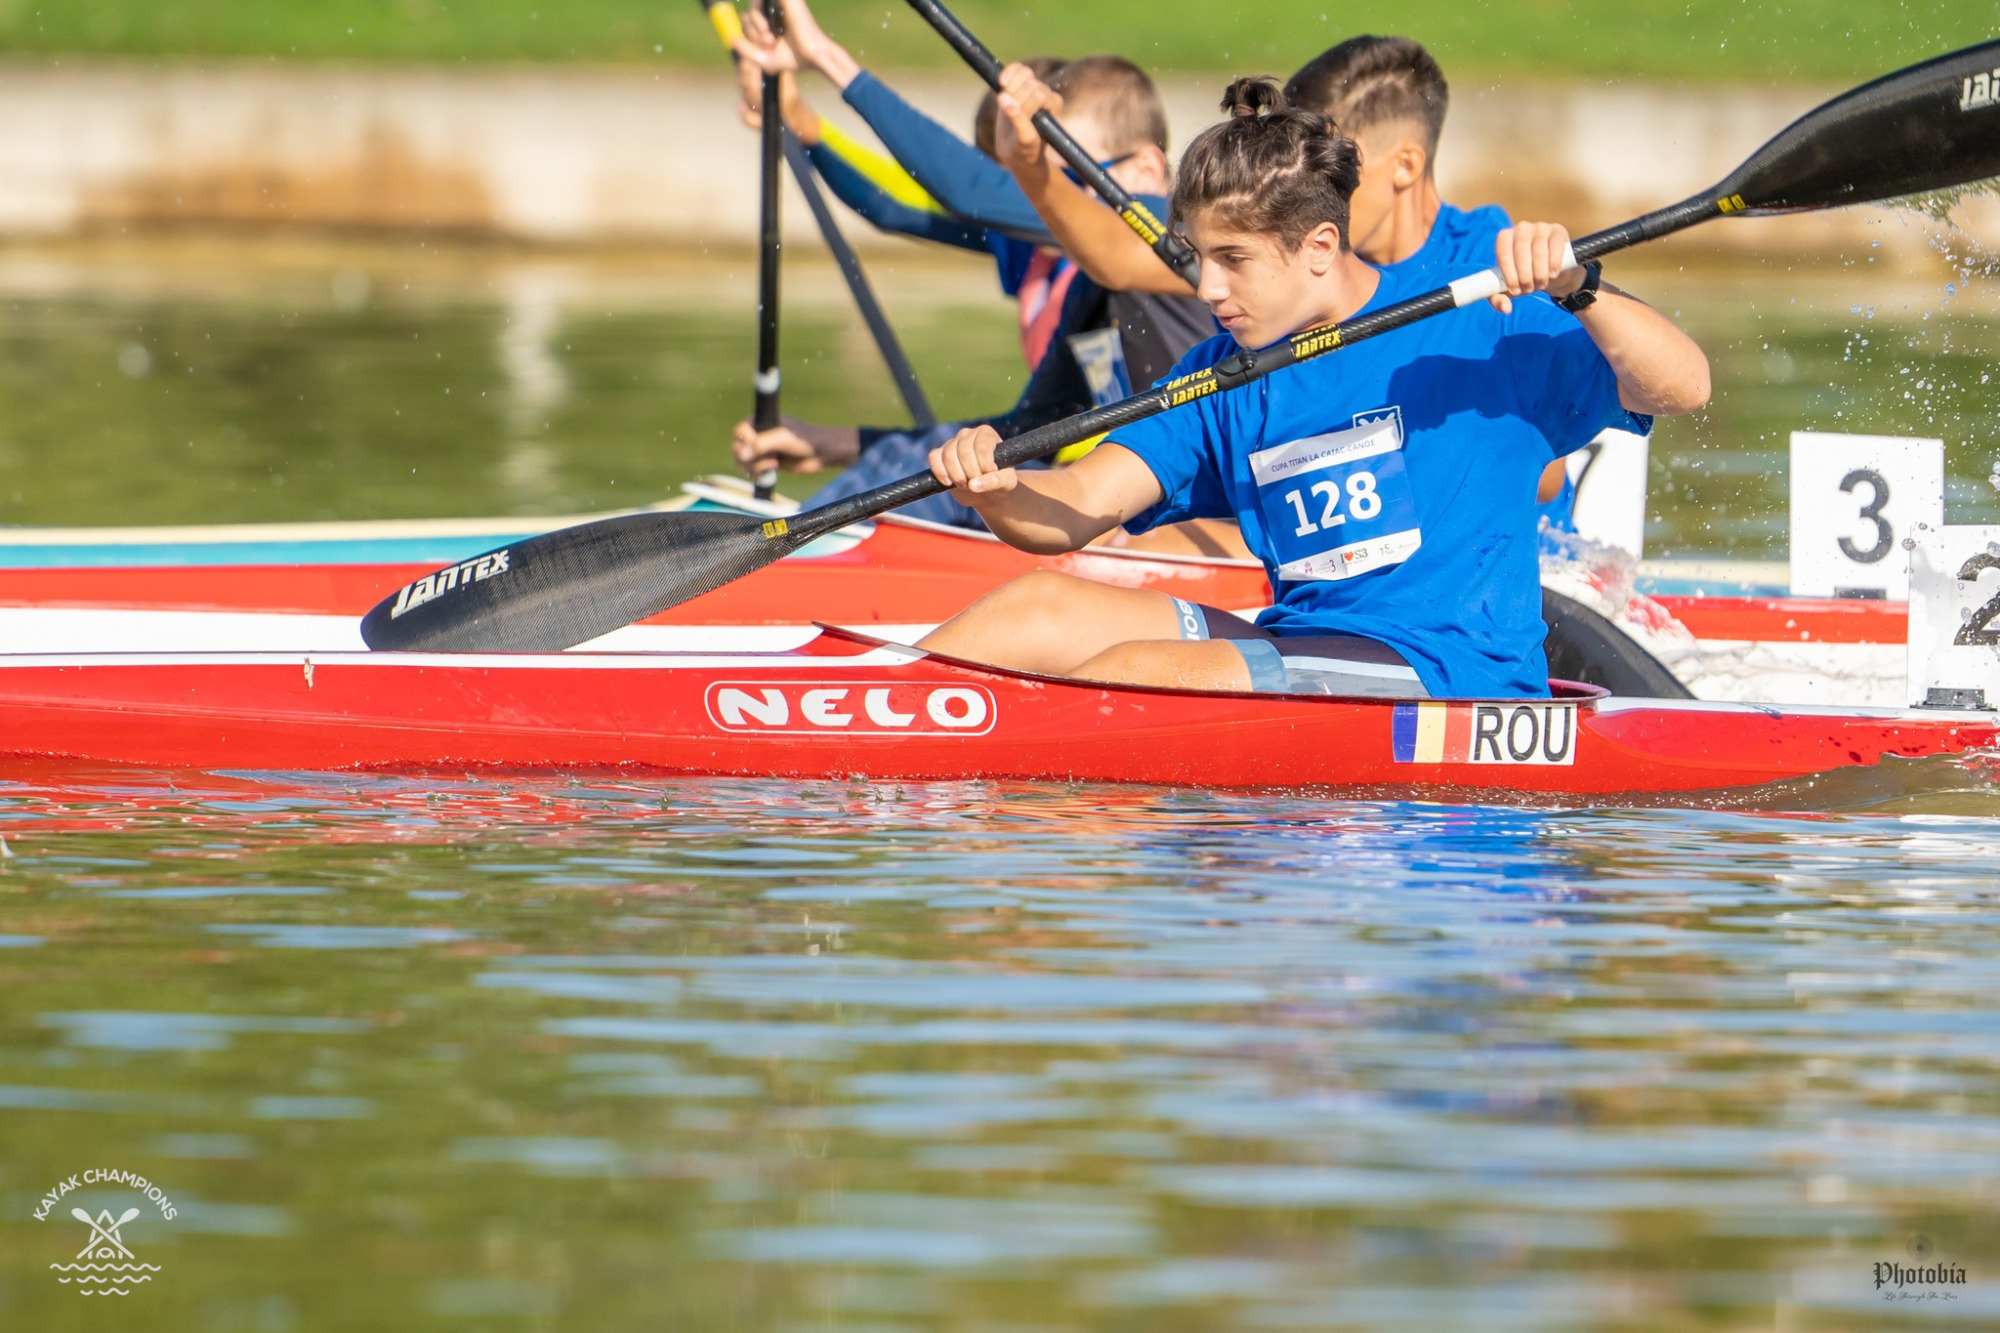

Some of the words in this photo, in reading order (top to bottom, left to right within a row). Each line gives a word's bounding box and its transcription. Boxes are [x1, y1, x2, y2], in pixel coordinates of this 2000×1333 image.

[1295, 330, 1341, 359] JANTEX
[1172, 378, 1218, 406] JANTEX
[1271, 462, 1288, 473] CUPA
[1288, 455, 1309, 468] TITAN
[1309, 452, 1320, 462] LA
[1285, 471, 1382, 537] 128
[1837, 469, 1894, 563] 3
[391, 549, 509, 620] JANTEX
[718, 688, 987, 727] NELO
[1474, 705, 1571, 762] ROU
